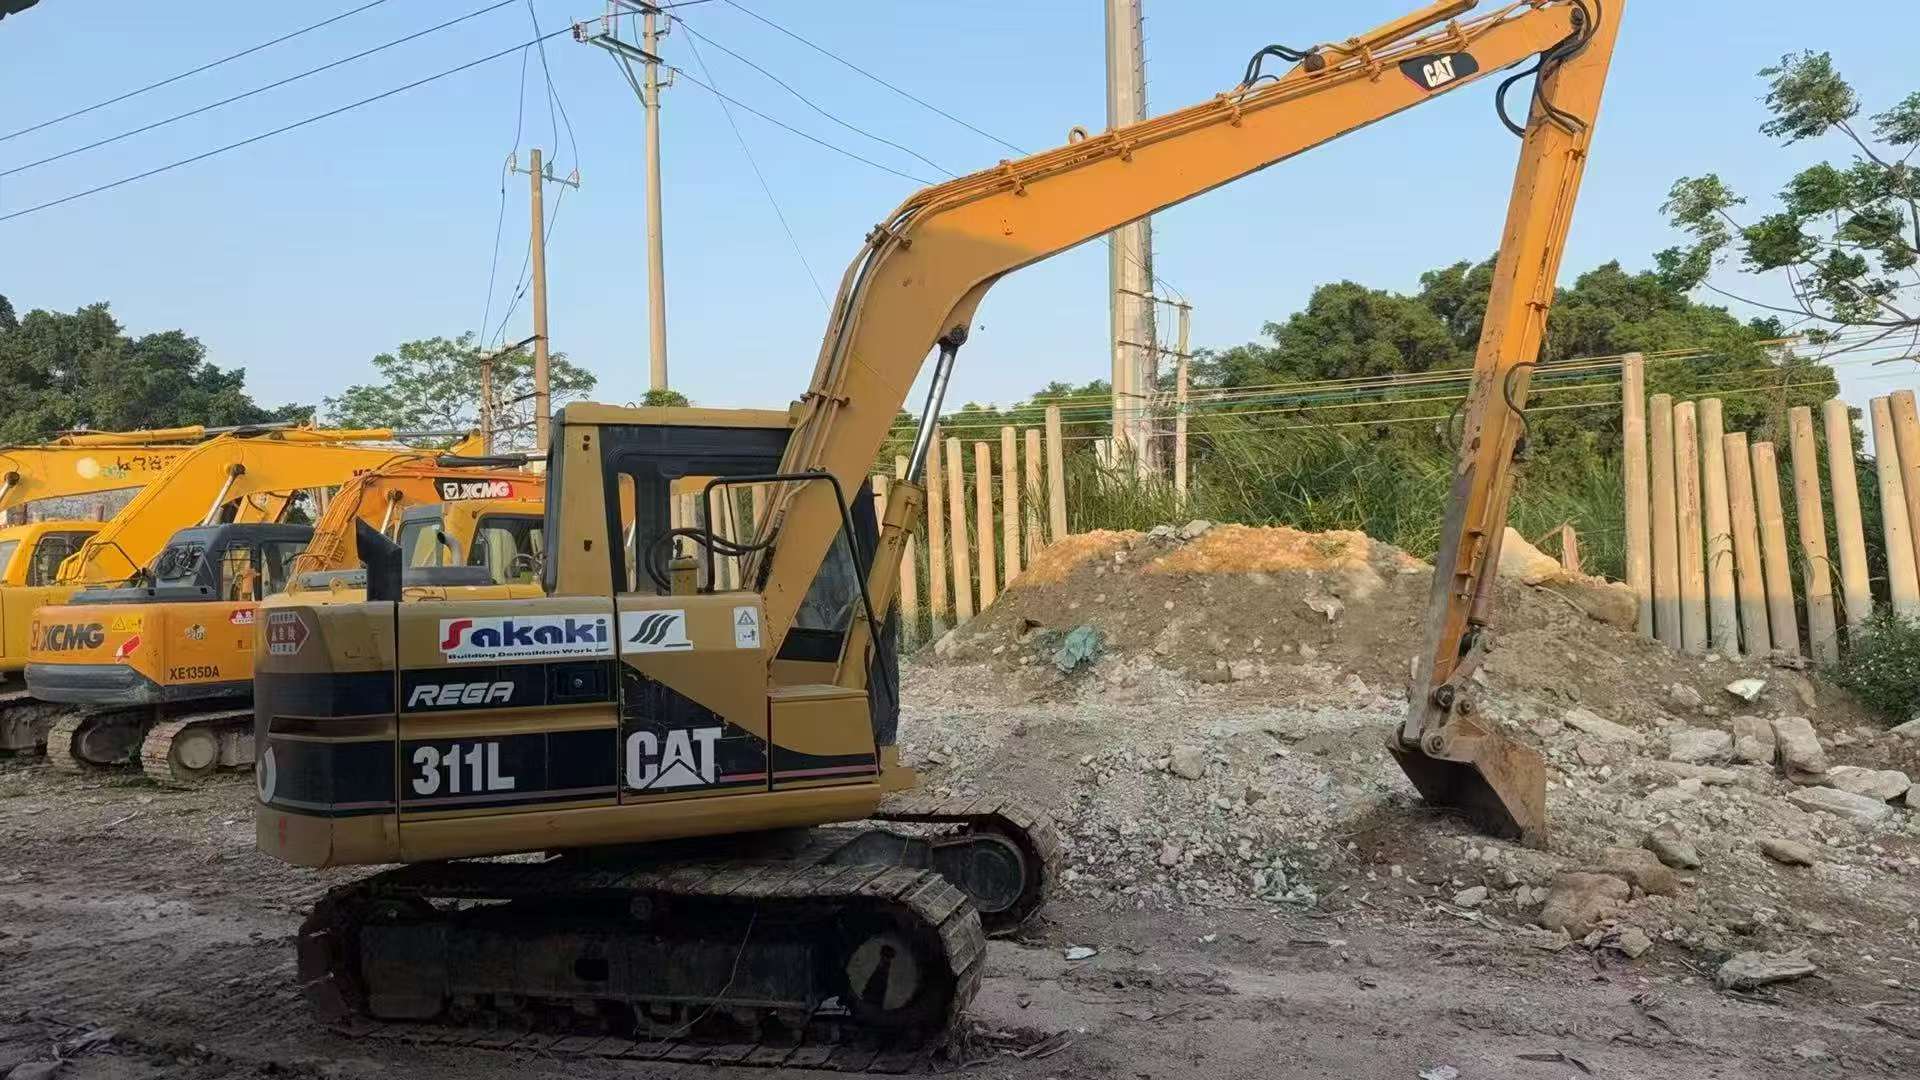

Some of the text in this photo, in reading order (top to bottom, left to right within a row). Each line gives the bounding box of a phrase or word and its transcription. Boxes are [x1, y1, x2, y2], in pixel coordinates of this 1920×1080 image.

[1423, 55, 1456, 87] CAT
[461, 481, 510, 498] XCMG
[40, 623, 105, 651] XCMG
[441, 618, 607, 650] Sakaki
[448, 652, 496, 660] Building
[169, 666, 220, 680] XE135DA
[407, 681, 515, 707] REGA
[412, 742, 515, 795] 311L
[626, 727, 722, 789] CAT
